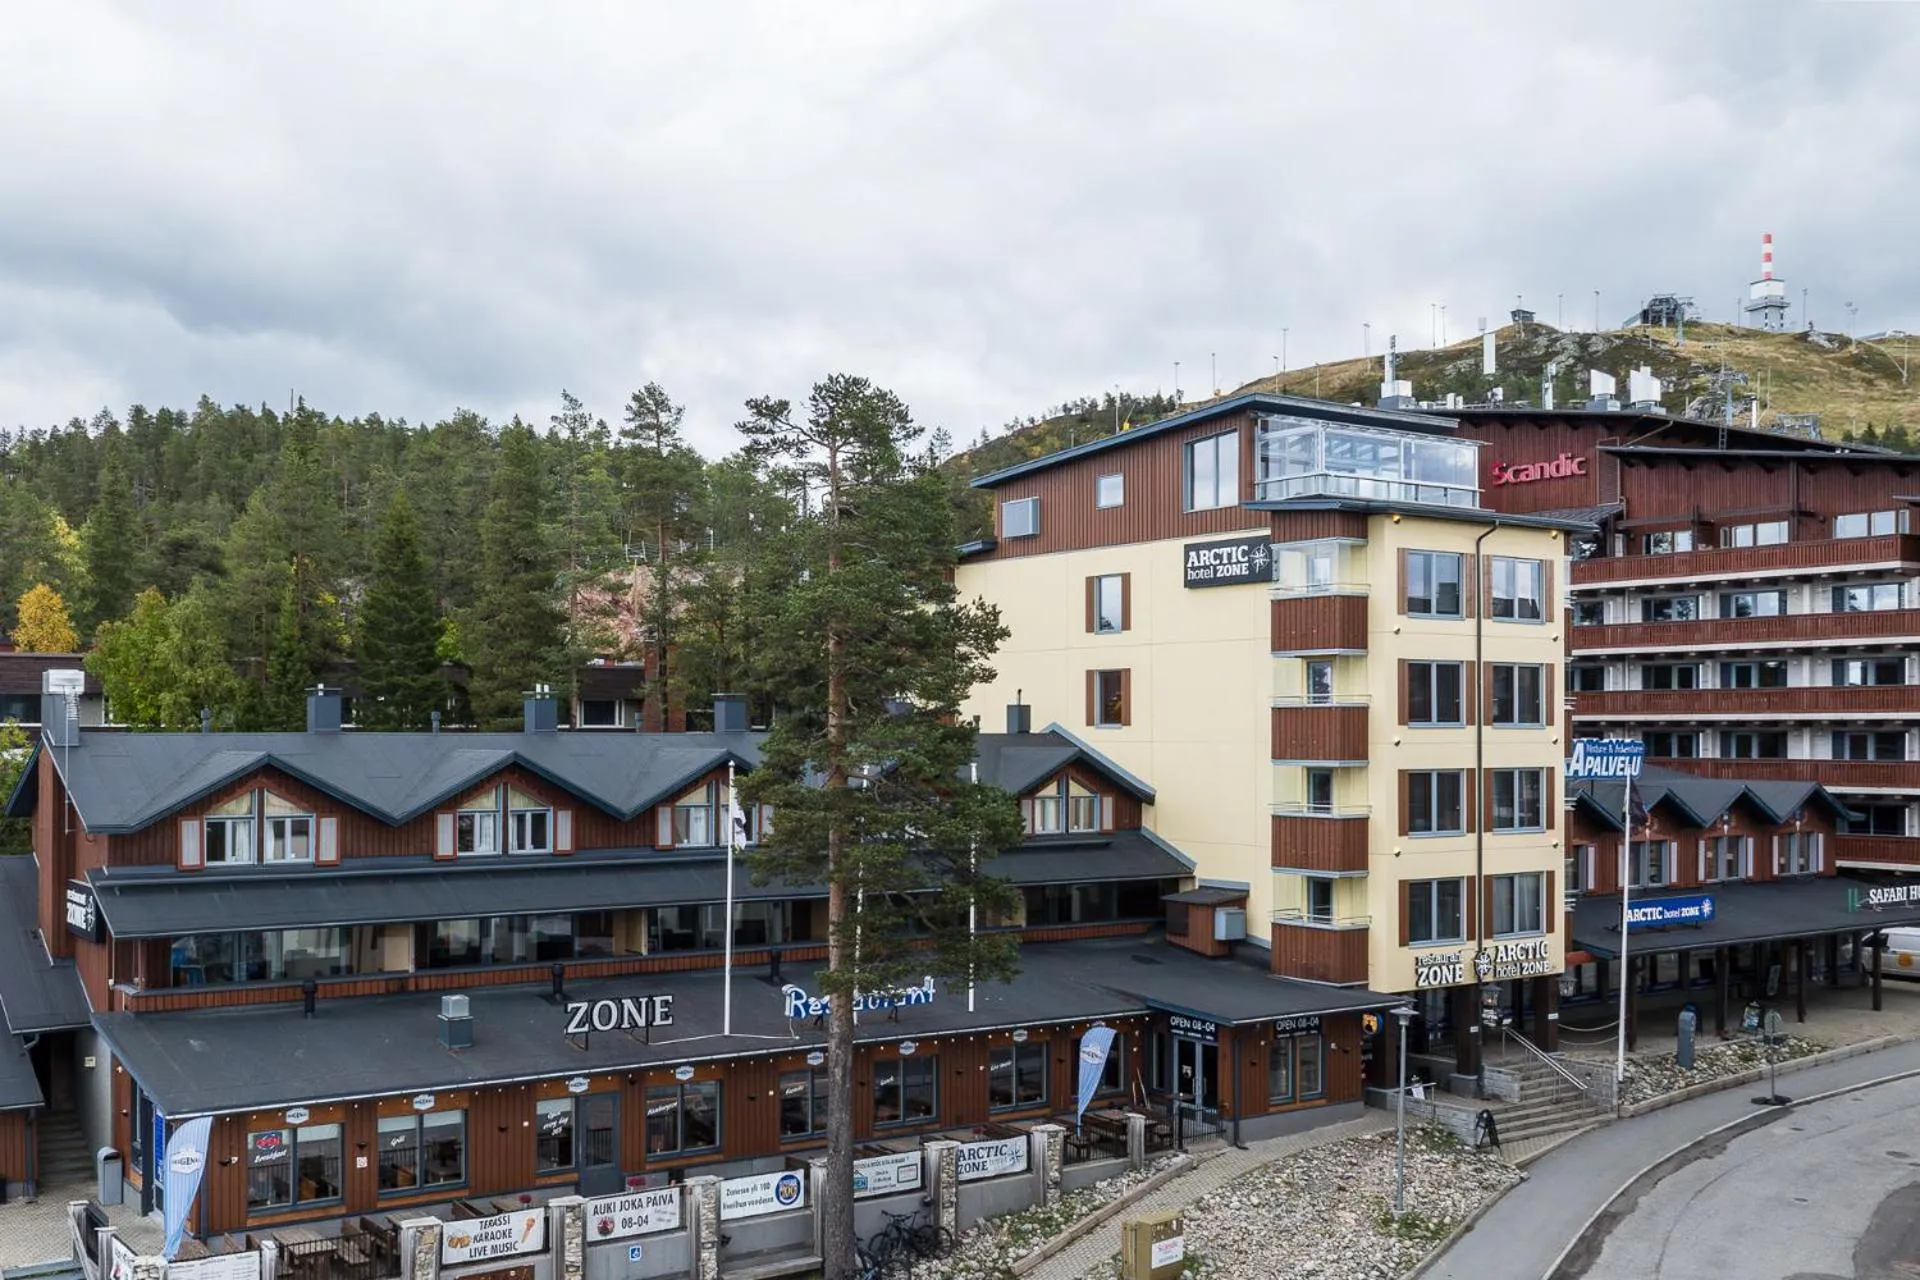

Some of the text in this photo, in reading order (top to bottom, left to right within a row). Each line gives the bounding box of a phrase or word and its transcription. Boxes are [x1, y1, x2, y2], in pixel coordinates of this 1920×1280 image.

[1491, 452, 1586, 486] Scandic
[1187, 545, 1248, 567] ARCTIC
[1188, 563, 1249, 580] hotel ZONE
[1869, 887, 1908, 904] SAFARI
[1627, 907, 1699, 921] ARCTIC hotel ZONE
[1496, 942, 1549, 962] ARCTIC
[1417, 964, 1464, 987] ZONE
[1522, 961, 1550, 975] ZONE
[566, 996, 673, 1034] ZONE
[1170, 1016, 1190, 1028] OPEN
[1276, 1020, 1296, 1031] OPEN
[958, 1144, 1009, 1162] ARCTIC
[958, 1160, 989, 1175] ZONE
[593, 1202, 616, 1216] AUKI
[619, 1198, 643, 1213] JOKA
[480, 1215, 511, 1231] TERASSI
[621, 1215, 649, 1229] 08-04
[472, 1228, 513, 1244] KARAOKE
[469, 1241, 519, 1259] LIVE MUSIC
